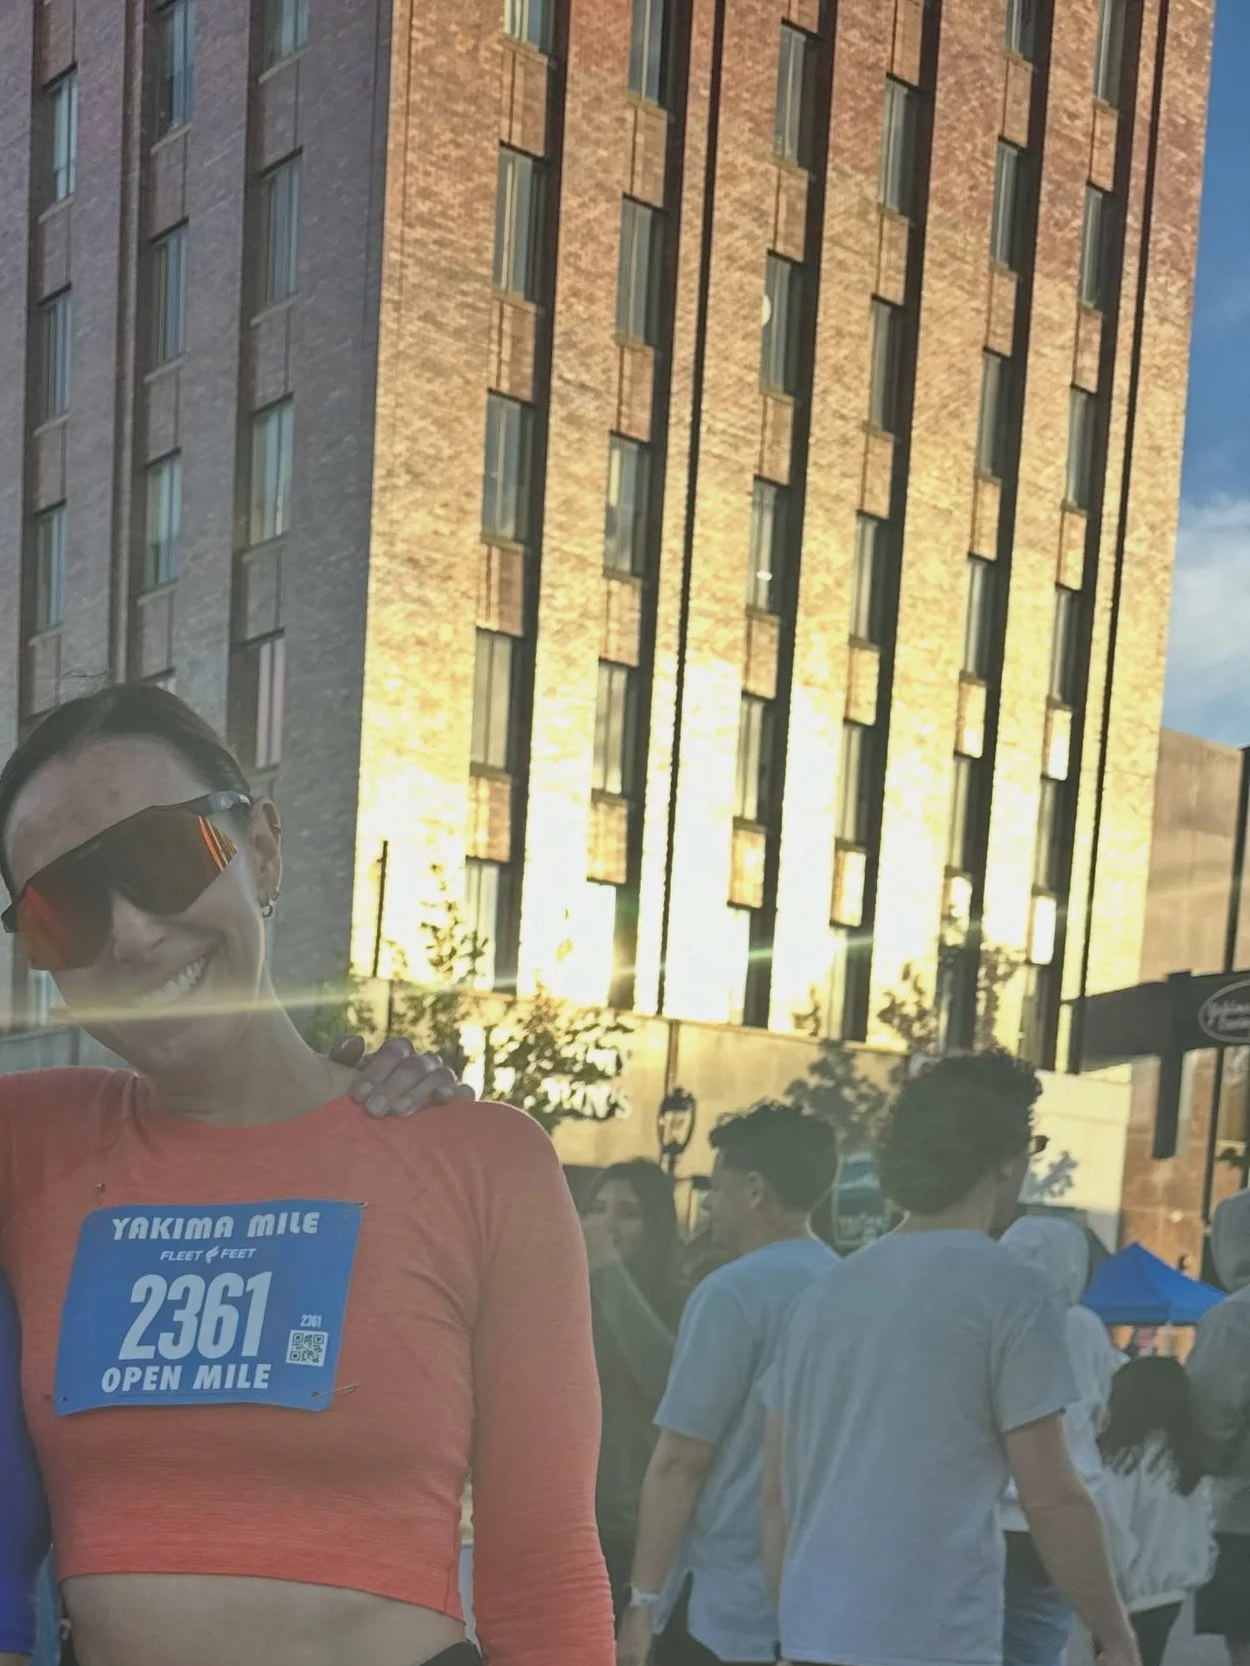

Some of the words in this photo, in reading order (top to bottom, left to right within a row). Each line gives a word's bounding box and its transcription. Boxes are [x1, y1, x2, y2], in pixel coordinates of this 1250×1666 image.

[112, 1215, 234, 1241] YAKIMA
[247, 1211, 321, 1238] MILE
[160, 1250, 203, 1262] FLEET
[220, 1247, 257, 1259] FEET
[118, 1271, 273, 1361] 2361
[300, 1314, 323, 1328] 2361
[101, 1365, 183, 1393] OPEN
[193, 1363, 272, 1390] MILE
